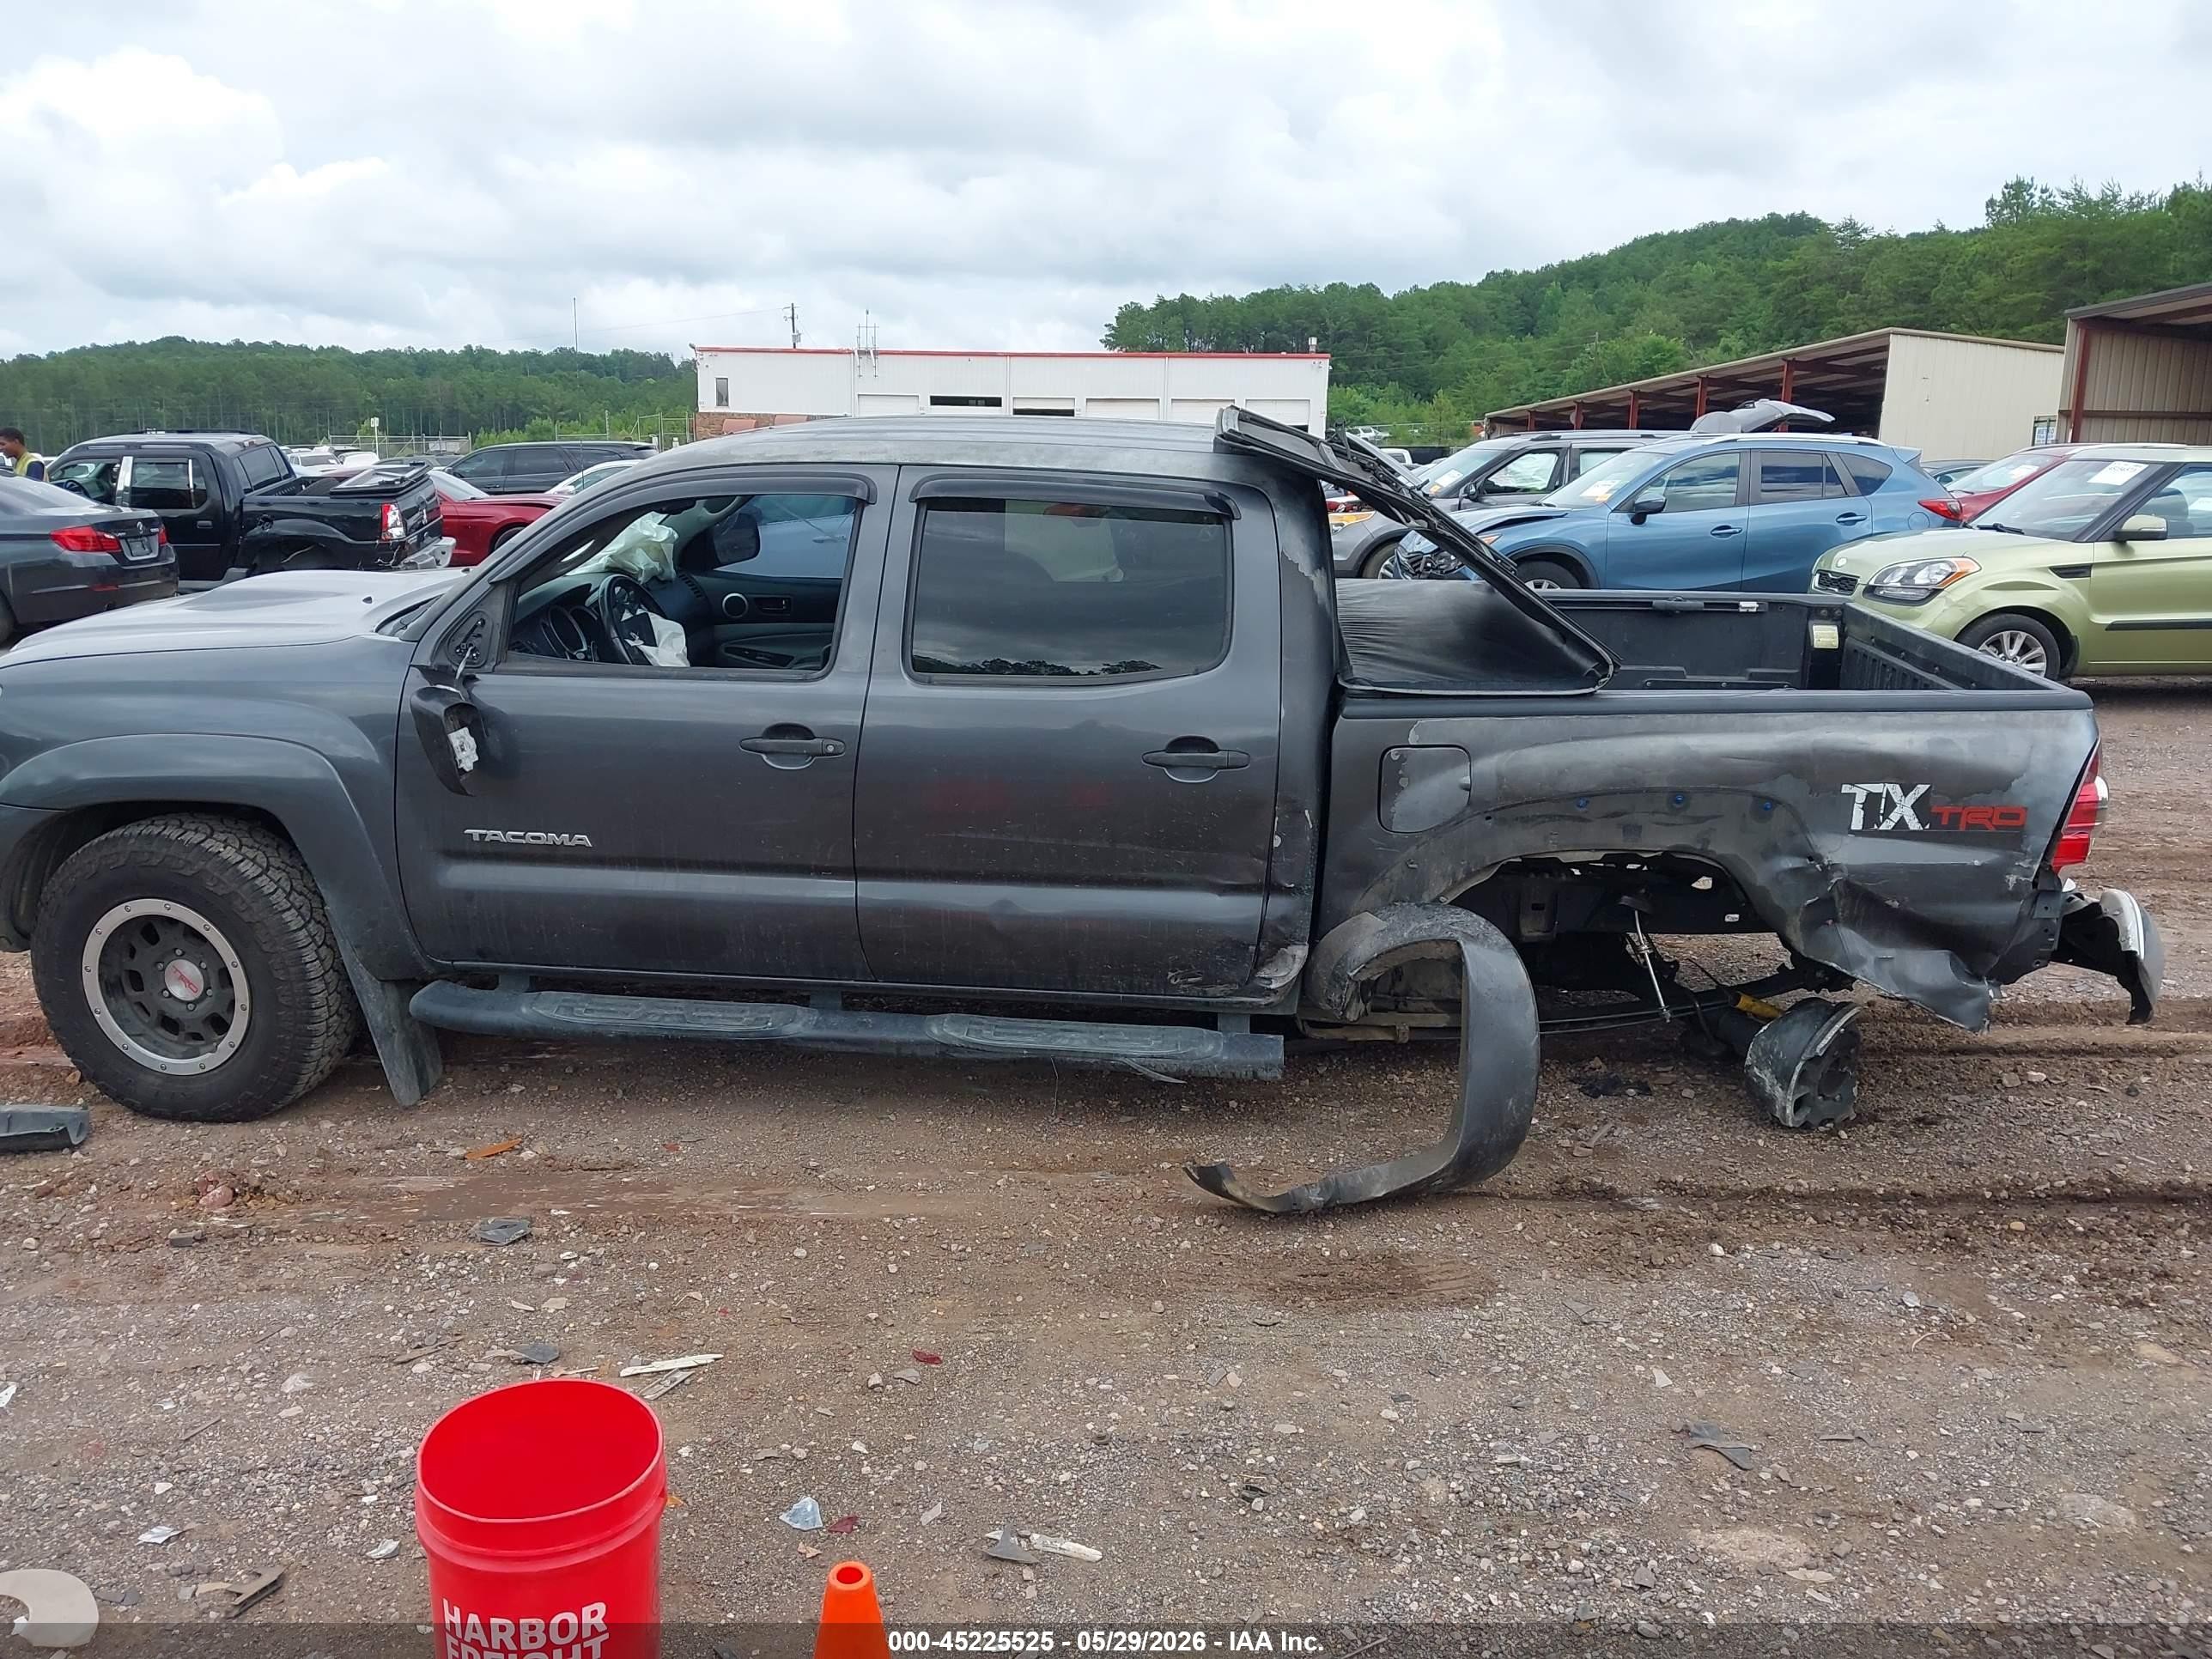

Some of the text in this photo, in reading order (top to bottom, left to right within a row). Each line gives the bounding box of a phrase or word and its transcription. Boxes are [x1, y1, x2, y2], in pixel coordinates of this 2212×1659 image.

[1930, 805, 2028, 831] TRD
[464, 829, 592, 848] TACOMA
[172, 964, 198, 994] TRD
[442, 1597, 608, 1650] HARBOR
